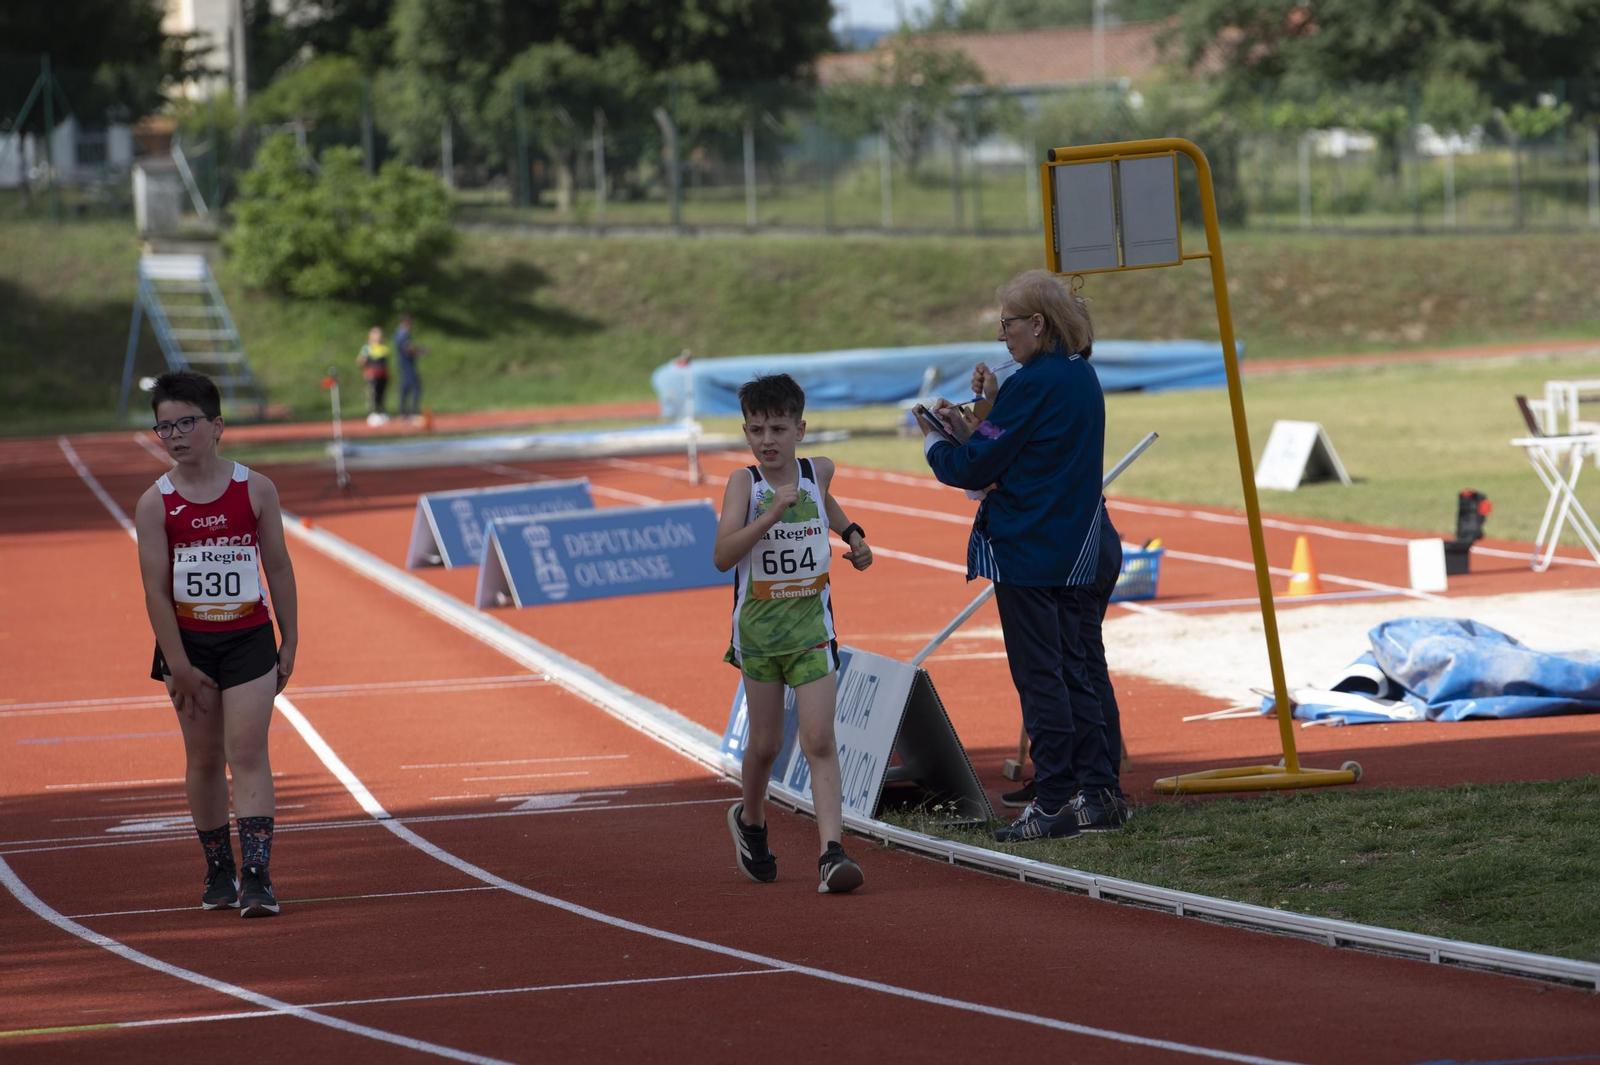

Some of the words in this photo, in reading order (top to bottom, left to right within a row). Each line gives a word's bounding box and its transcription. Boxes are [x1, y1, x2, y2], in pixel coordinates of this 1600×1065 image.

[191, 514, 227, 529] CUPA
[562, 519, 698, 559] DEPUTACIÓN
[760, 532, 771, 540] a
[177, 552, 197, 563] La
[762, 546, 817, 575] 664
[186, 572, 241, 597] 530
[573, 554, 674, 589] OURENSE
[770, 587, 818, 599] telemiño
[835, 669, 881, 731] XUNTA
[838, 743, 878, 812] ALICIA
